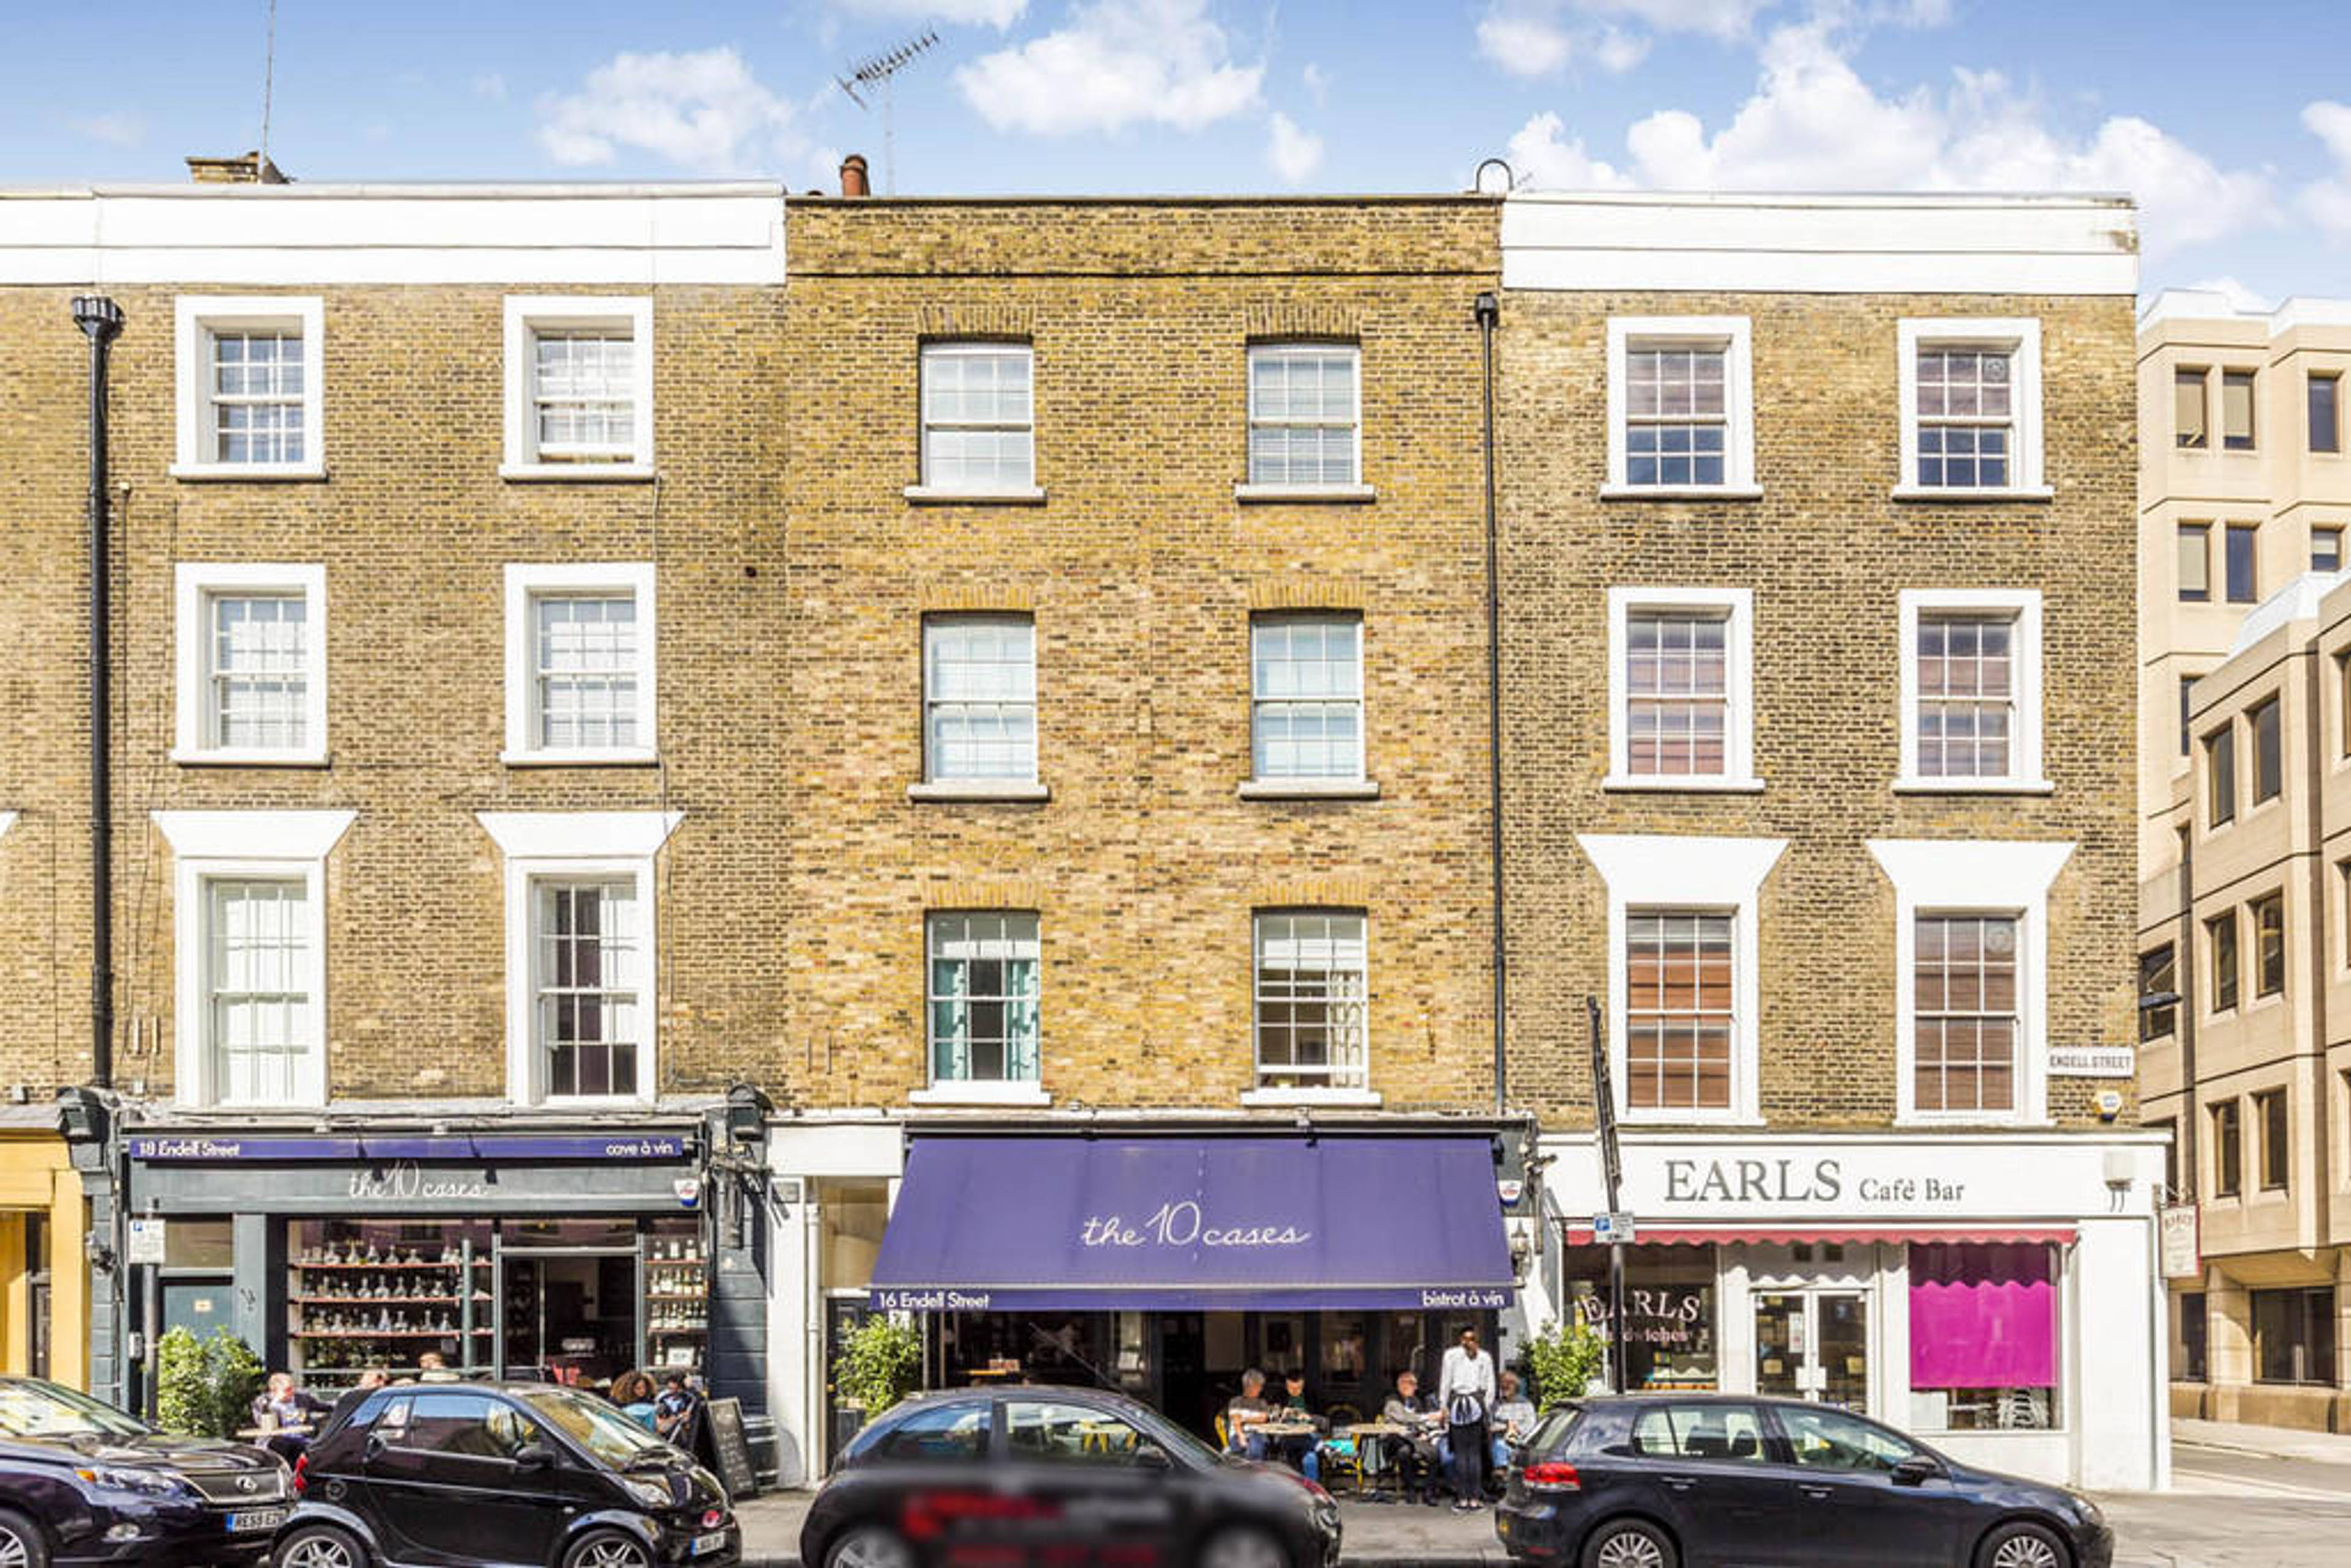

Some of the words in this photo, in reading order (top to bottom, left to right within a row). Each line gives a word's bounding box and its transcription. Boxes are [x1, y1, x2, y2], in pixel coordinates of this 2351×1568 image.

[2050, 1054, 2088, 1067] ENDELL
[2091, 1056, 2131, 1068] STREET
[159, 1141, 200, 1156] Endell
[202, 1142, 240, 1157] Street
[606, 1144, 637, 1156] cave
[640, 1140, 651, 1155] à
[653, 1140, 673, 1155] vin
[349, 1170, 386, 1198] the
[385, 1160, 419, 1197] 10
[422, 1182, 489, 1198] cases
[1664, 1159, 1842, 1202] EARLS
[1925, 1178, 1965, 1202] Bar
[1081, 1217, 1146, 1246] the
[1145, 1201, 1201, 1245] 10
[1202, 1225, 1311, 1247] cases
[879, 1292, 898, 1309] 16
[900, 1291, 945, 1308] Endell
[947, 1292, 990, 1309] Street
[1423, 1290, 1466, 1307] bistrot
[1469, 1290, 1480, 1306] à
[1482, 1290, 1505, 1306] vin
